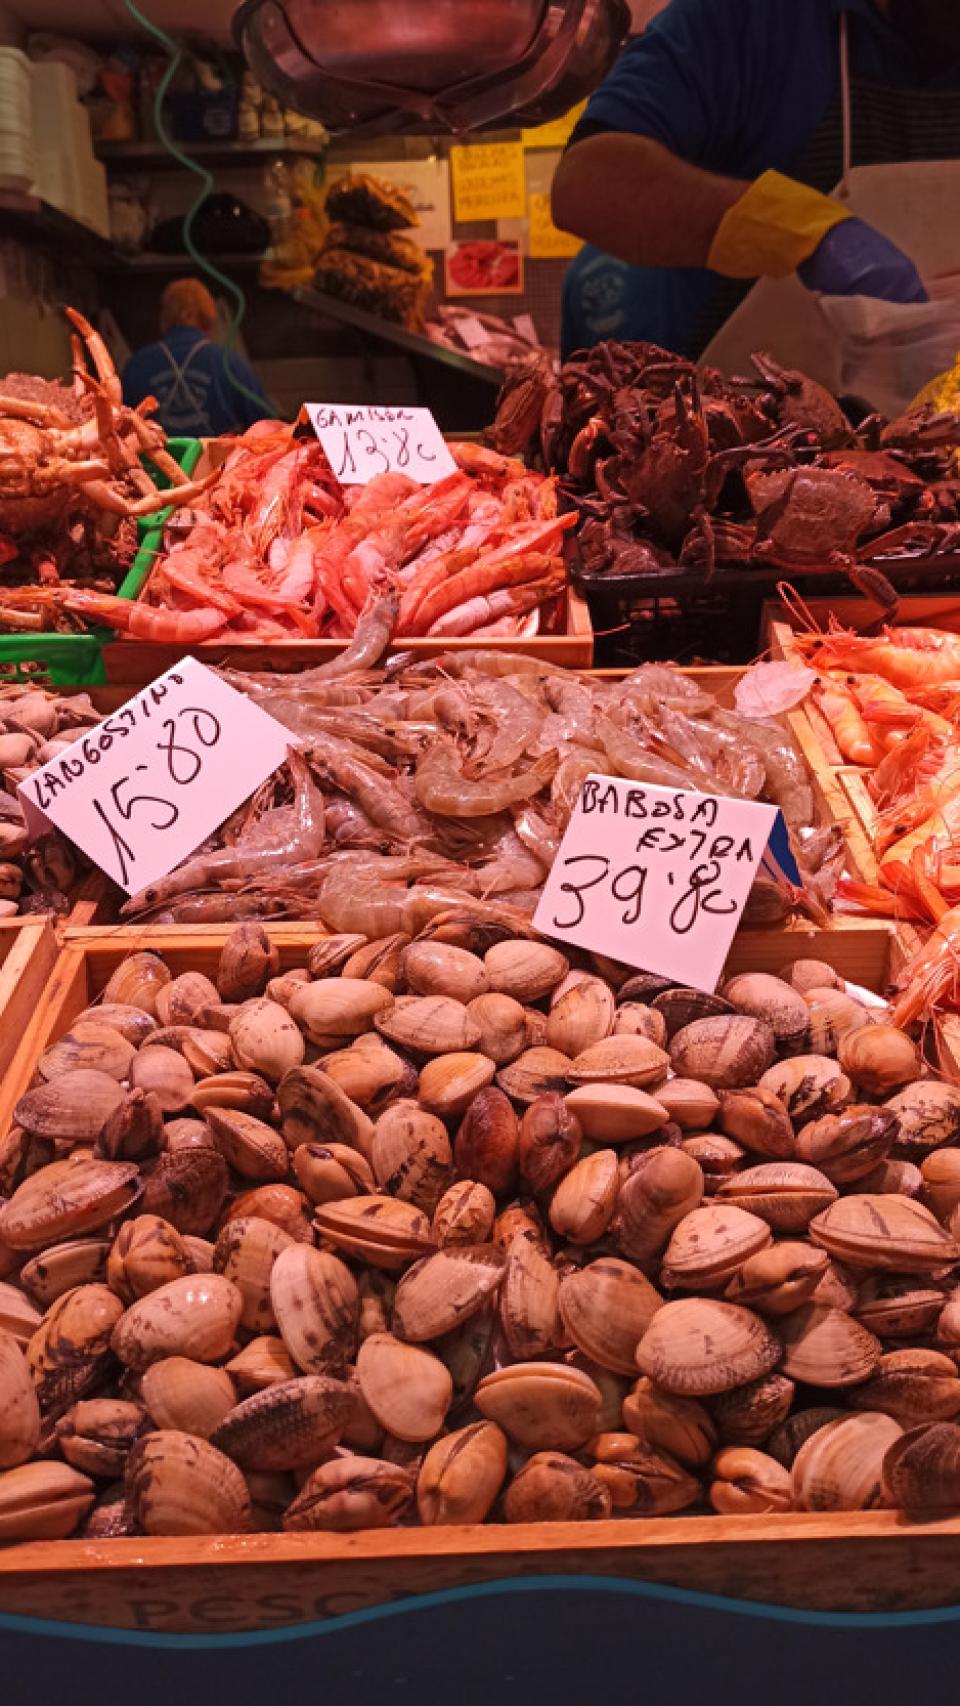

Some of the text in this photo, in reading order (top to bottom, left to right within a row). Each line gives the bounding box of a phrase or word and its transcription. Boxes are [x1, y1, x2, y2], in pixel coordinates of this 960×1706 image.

[34, 674, 184, 809] LANGOSTINO
[581, 780, 718, 827] BABOSA
[636, 827, 753, 862] EXTRA
